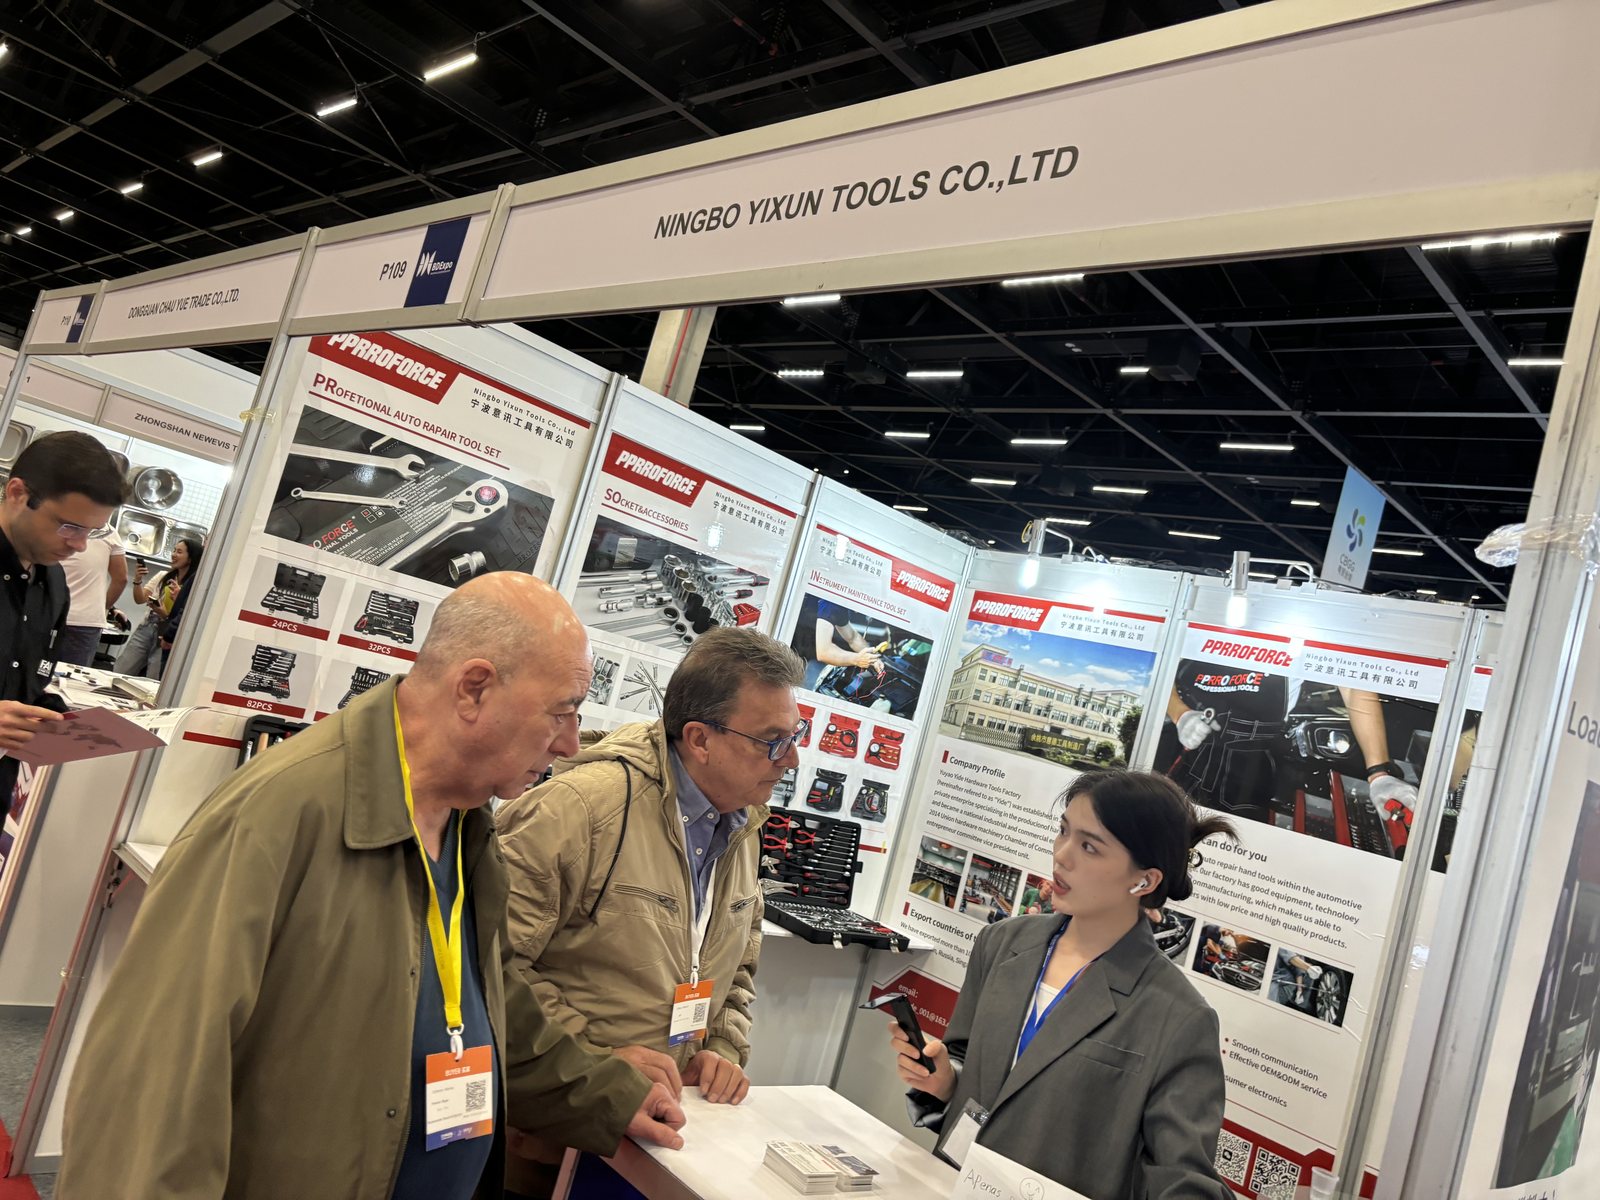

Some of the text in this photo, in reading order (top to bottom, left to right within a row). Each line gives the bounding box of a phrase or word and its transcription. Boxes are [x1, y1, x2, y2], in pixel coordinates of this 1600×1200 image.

[654, 145, 1079, 239] NINGBO YIXUN TOOLS CO.,LTD
[379, 260, 407, 281] P109
[128, 302, 160, 319] DONGGUAN
[159, 299, 177, 314] CHAU
[176, 297, 190, 311] YUE
[189, 293, 212, 309] TRADE
[327, 333, 446, 390] PPRROFORCE
[312, 372, 502, 459] PROFETIONAL AUTO RAPAIR TOOL SET
[470, 398, 574, 449] 宁波意讯工具有限公司
[473, 387, 501, 404] Ningbo
[503, 400, 524, 414] Yixun
[526, 410, 545, 423] Tools
[563, 426, 576, 436] Ltd
[134, 413, 191, 437] ZHONGSHAN
[192, 432, 231, 450] NEWEVIS
[615, 450, 698, 496] PPRROFORCE
[604, 488, 689, 532] SOCKET&ACCESSORIES
[713, 500, 785, 537] 宁波意讯工具有限公司
[715, 491, 735, 504] Ningbo
[751, 507, 765, 518] Tools
[777, 518, 787, 526] Ltd
[321, 519, 356, 545] FORCE
[338, 527, 359, 542] TOOLS
[810, 569, 907, 616] INSTRUMENT MAINTENANCE TOOL SET
[896, 569, 951, 603] PPRROFORCE
[272, 619, 298, 632] 24PCS
[972, 599, 1045, 623] PPRROFORCE
[1062, 612, 1083, 622] Ningbo
[1102, 619, 1119, 627] Tools
[1060, 621, 1144, 642] 宁波意讯工具有限公司
[367, 642, 391, 655] 32PCS
[1200, 639, 1293, 667] PPRROFORCE
[1228, 672, 1264, 685] FORCE
[1303, 662, 1418, 690] 宁波意讯工具有限公司
[1305, 653, 1333, 663] Ningbo
[1335, 657, 1357, 667] Yixun
[1359, 661, 1382, 671] Tools
[1404, 669, 1419, 677] Ltd
[1237, 684, 1260, 693] TOOLS
[246, 699, 273, 712] 82PCS
[949, 756, 1006, 779] Company Profile
[939, 769, 1021, 800] Yuyao Yide Hardware Tools Factory
[931, 799, 942, 808] and
[941, 801, 959, 812] became
[963, 809, 984, 821] national
[983, 816, 1008, 829] industrial
[1007, 824, 1018, 832] and
[1017, 828, 1049, 843] commercial
[933, 790, 950, 800] private
[950, 795, 975, 807] enterprise
[974, 802, 1003, 817] specializing
[1003, 810, 1009, 818] in
[1008, 812, 1018, 821] the
[1012, 803, 1022, 811] was
[1022, 806, 1053, 820] established
[1053, 814, 1059, 822] in
[926, 820, 957, 834] entrepreneur
[956, 829, 982, 844] committee
[982, 838, 993, 847] vice
[993, 842, 1018, 855] president
[928, 808, 1034, 849] 2014 Union hardware machinery Chamber of
[1220, 841, 1268, 863] do for you
[1212, 871, 1237, 886] factory
[1237, 879, 1250, 889] has
[1250, 884, 1270, 897] good
[1270, 890, 1314, 911] equipment,
[1216, 860, 1363, 911] repair hand tools within the automotive
[910, 908, 932, 924] Export
[932, 919, 964, 938] countries
[964, 932, 974, 940] of
[1200, 894, 1216, 905] with
[1216, 898, 1231, 909] low
[1230, 904, 1249, 916] price
[1249, 910, 1265, 921] and
[1264, 914, 1281, 927] high
[1282, 921, 1310, 937] quality
[1309, 931, 1348, 949] products.
[1255, 899, 1277, 912] which
[1277, 906, 1303, 920] makes
[1303, 915, 1313, 923] us
[1313, 918, 1332, 929] able
[1332, 924, 1342, 932] to
[900, 921, 907, 929] We
[908, 925, 919, 934] have
[919, 931, 940, 944] exported
[940, 940, 953, 949] more
[953, 944, 965, 954] than
[898, 984, 919, 998] email:
[1229, 1050, 1328, 1099] Effective OEM&ODM service
[1231, 1038, 1319, 1082] Smooth communication
[1247, 1084, 1288, 1108] electronics
